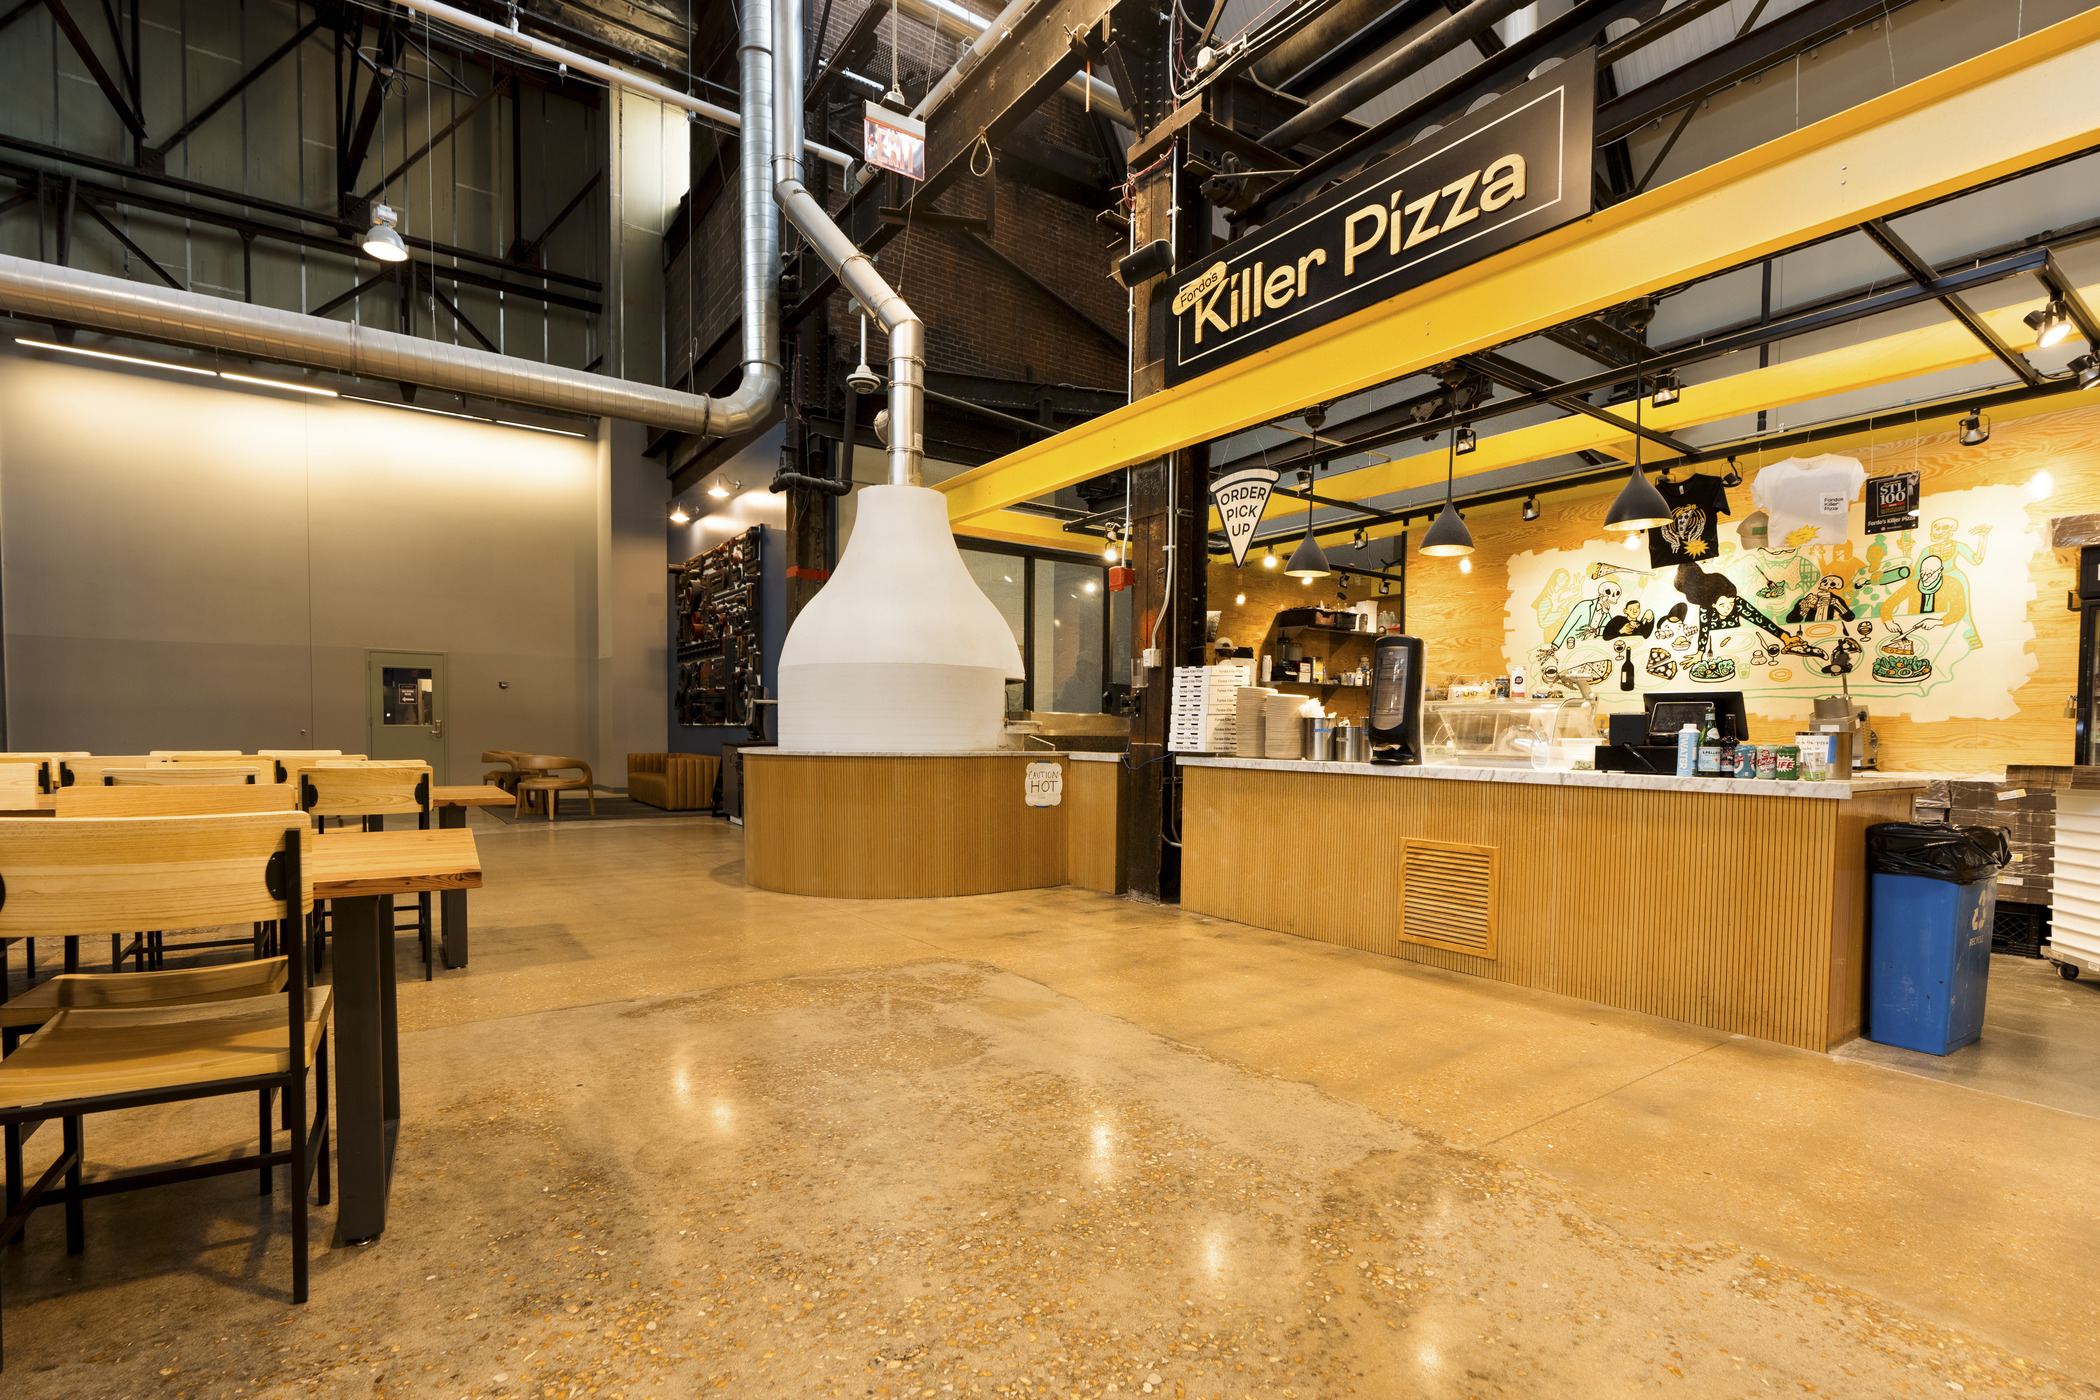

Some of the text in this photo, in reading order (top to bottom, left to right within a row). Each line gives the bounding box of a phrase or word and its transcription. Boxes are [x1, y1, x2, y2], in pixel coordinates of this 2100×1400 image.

[1195, 153, 1527, 344] Killer Pizza
[1180, 272, 1218, 308] Fordo's
[1220, 486, 1267, 506] ORDER
[1880, 482, 1906, 495] STL
[1880, 491, 1906, 505] 100
[1226, 505, 1259, 521] PICK
[1232, 523, 1251, 537] UP
[1679, 738, 1688, 769] WATER
[1028, 770, 1059, 780] CAUTION
[1031, 780, 1058, 793] HOT
